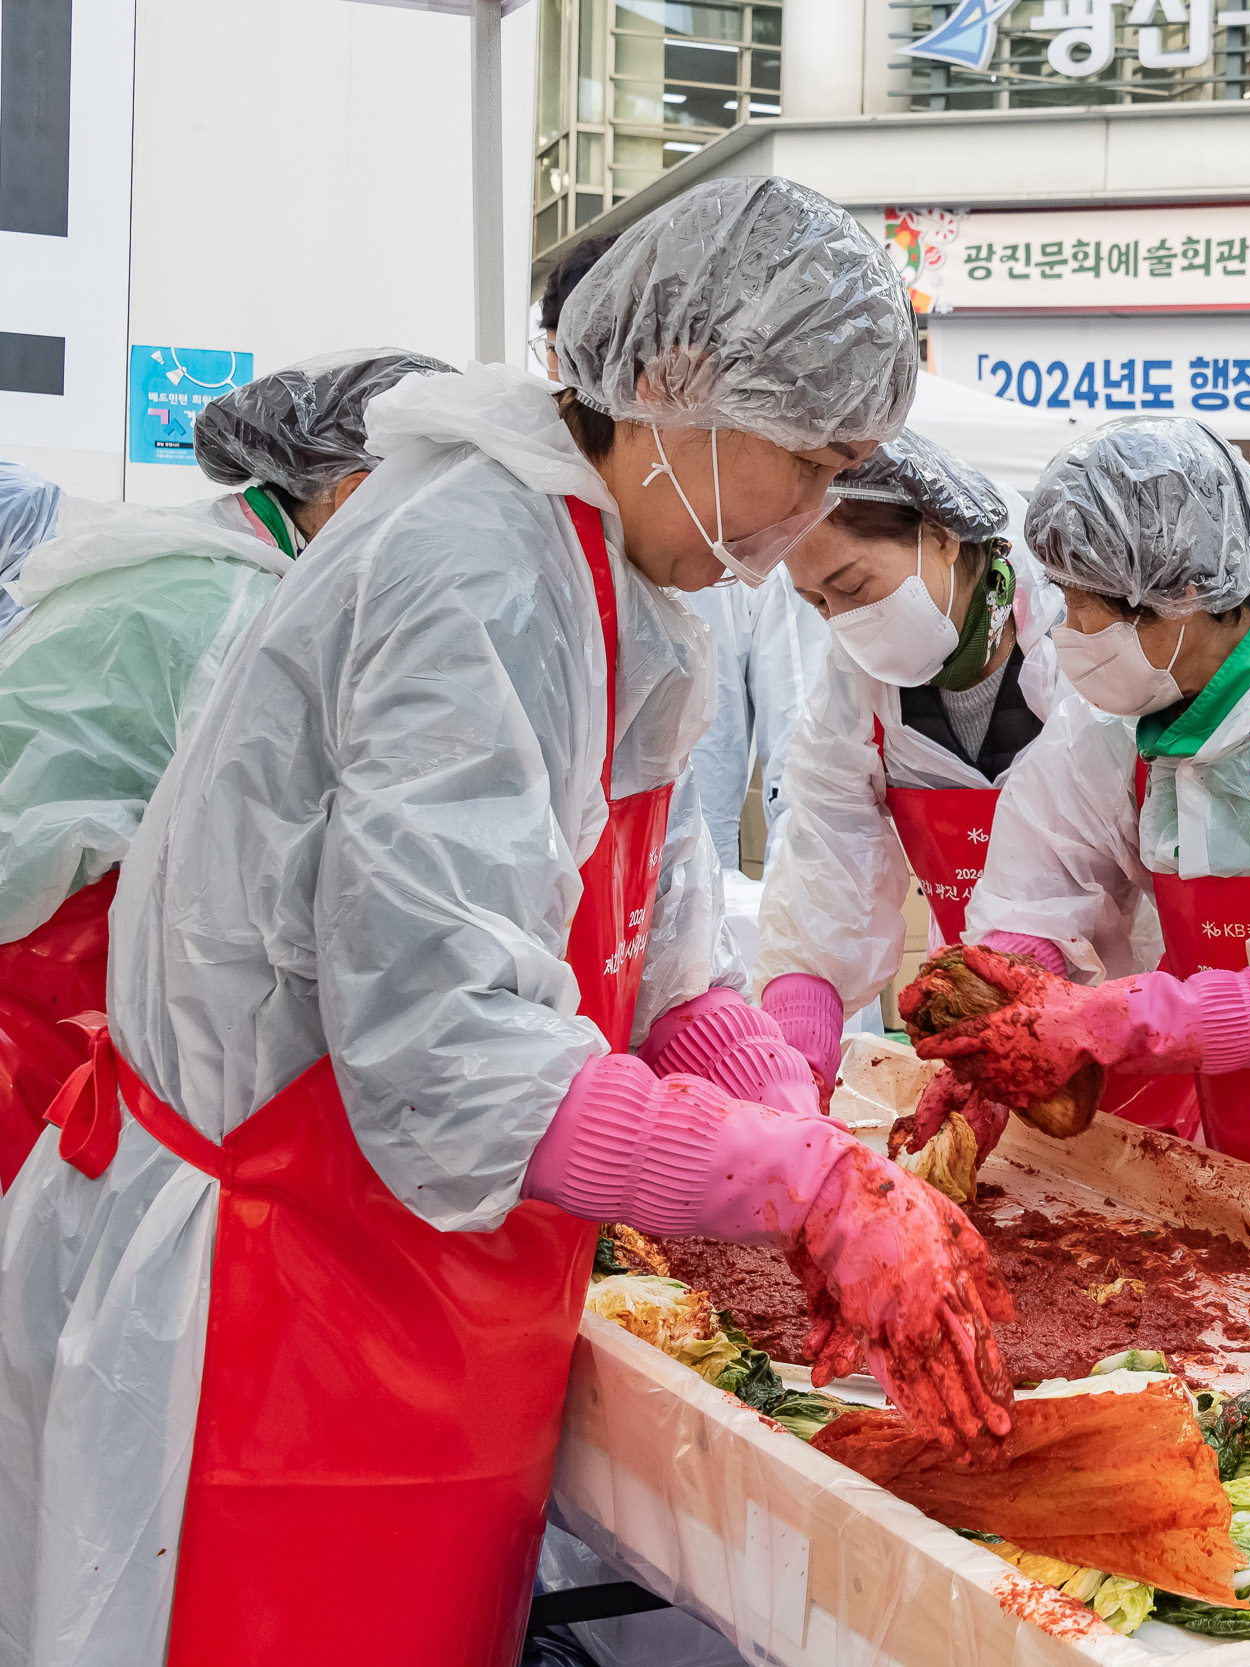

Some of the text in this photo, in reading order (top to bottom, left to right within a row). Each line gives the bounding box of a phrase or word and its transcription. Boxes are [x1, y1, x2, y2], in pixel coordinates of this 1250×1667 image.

[964, 236, 1250, 281] 광진문화예술회관
[148, 391, 219, 407] 배드민턴 회원
[955, 869, 984, 880] 2024
[628, 907, 646, 928] 2024
